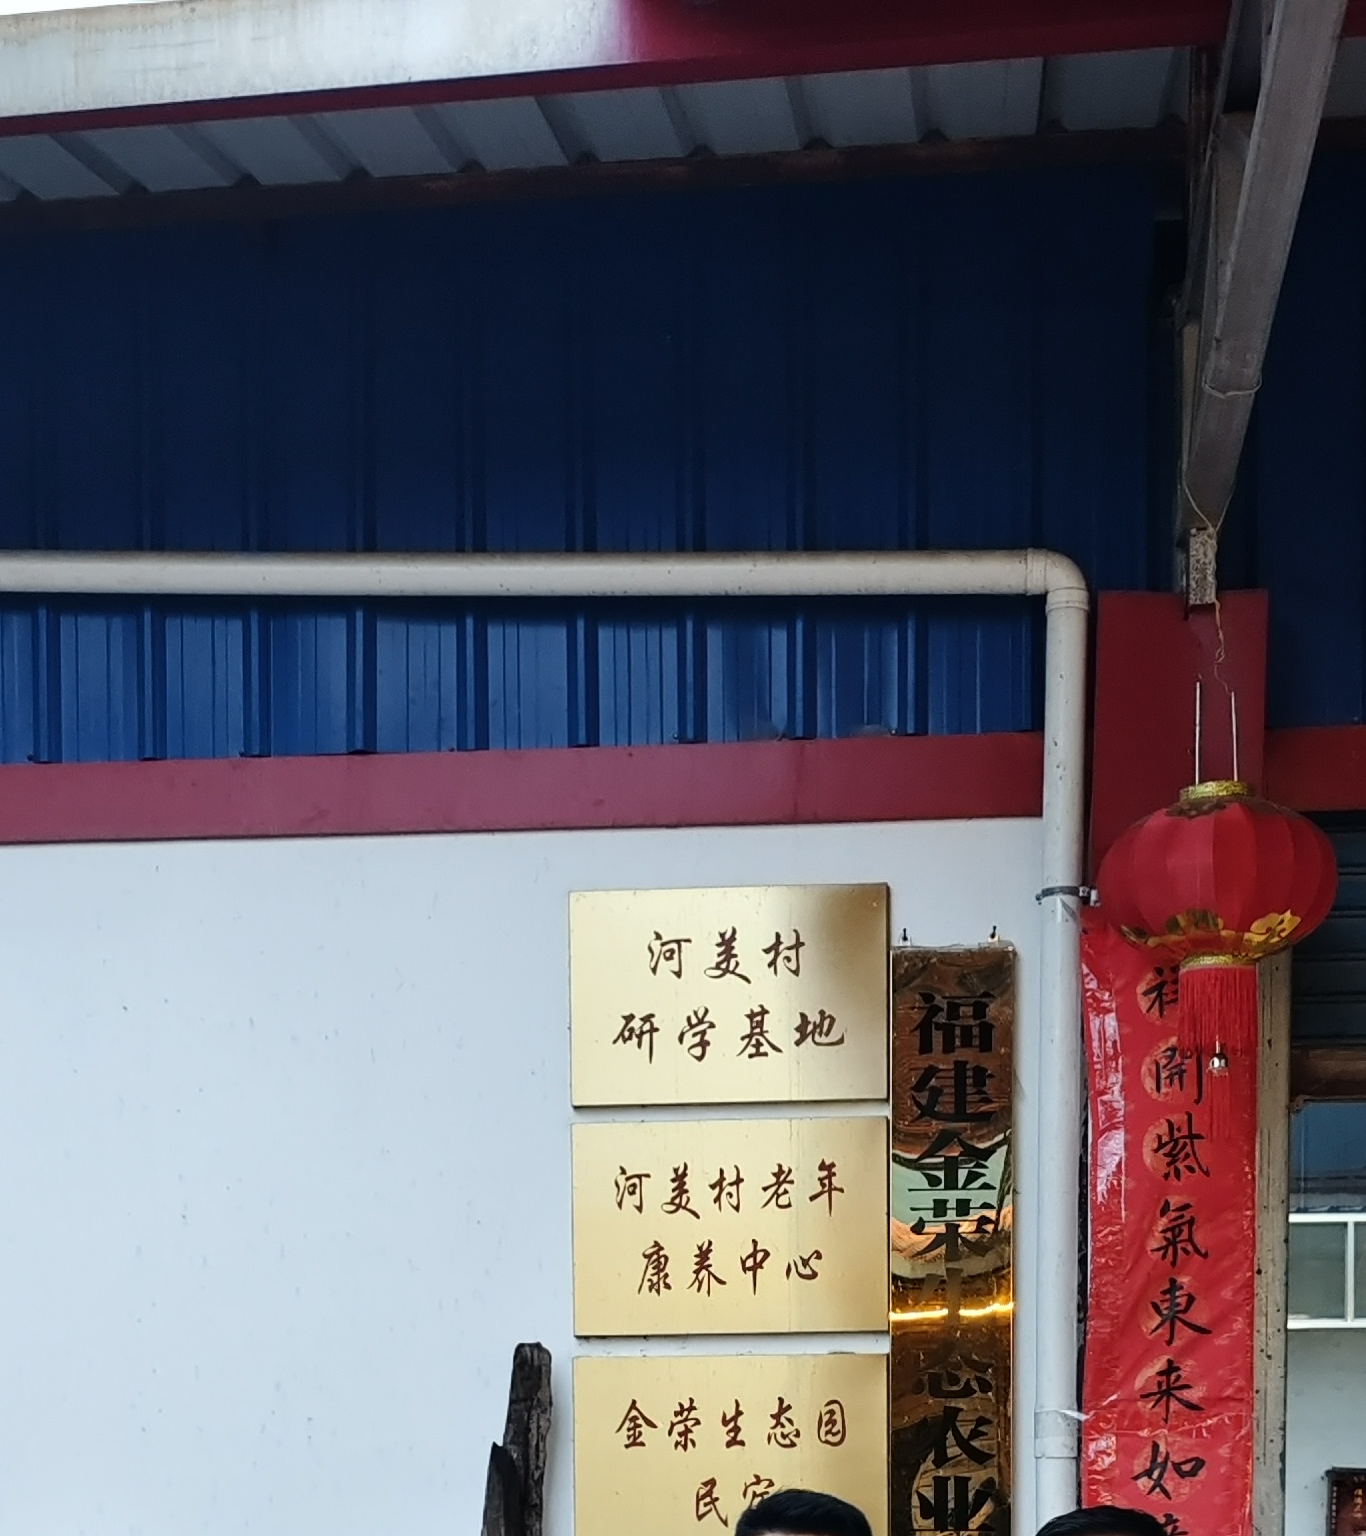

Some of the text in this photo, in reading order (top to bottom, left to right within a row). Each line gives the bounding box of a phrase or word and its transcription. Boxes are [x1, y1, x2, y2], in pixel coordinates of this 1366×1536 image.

[647, 926, 807, 984] 河美村
[612, 1004, 845, 1064] 研学基地
[613, 1158, 845, 1220] 河美村老年
[637, 1239, 823, 1297] 康养中心
[614, 1396, 848, 1452] 金荣生态园
